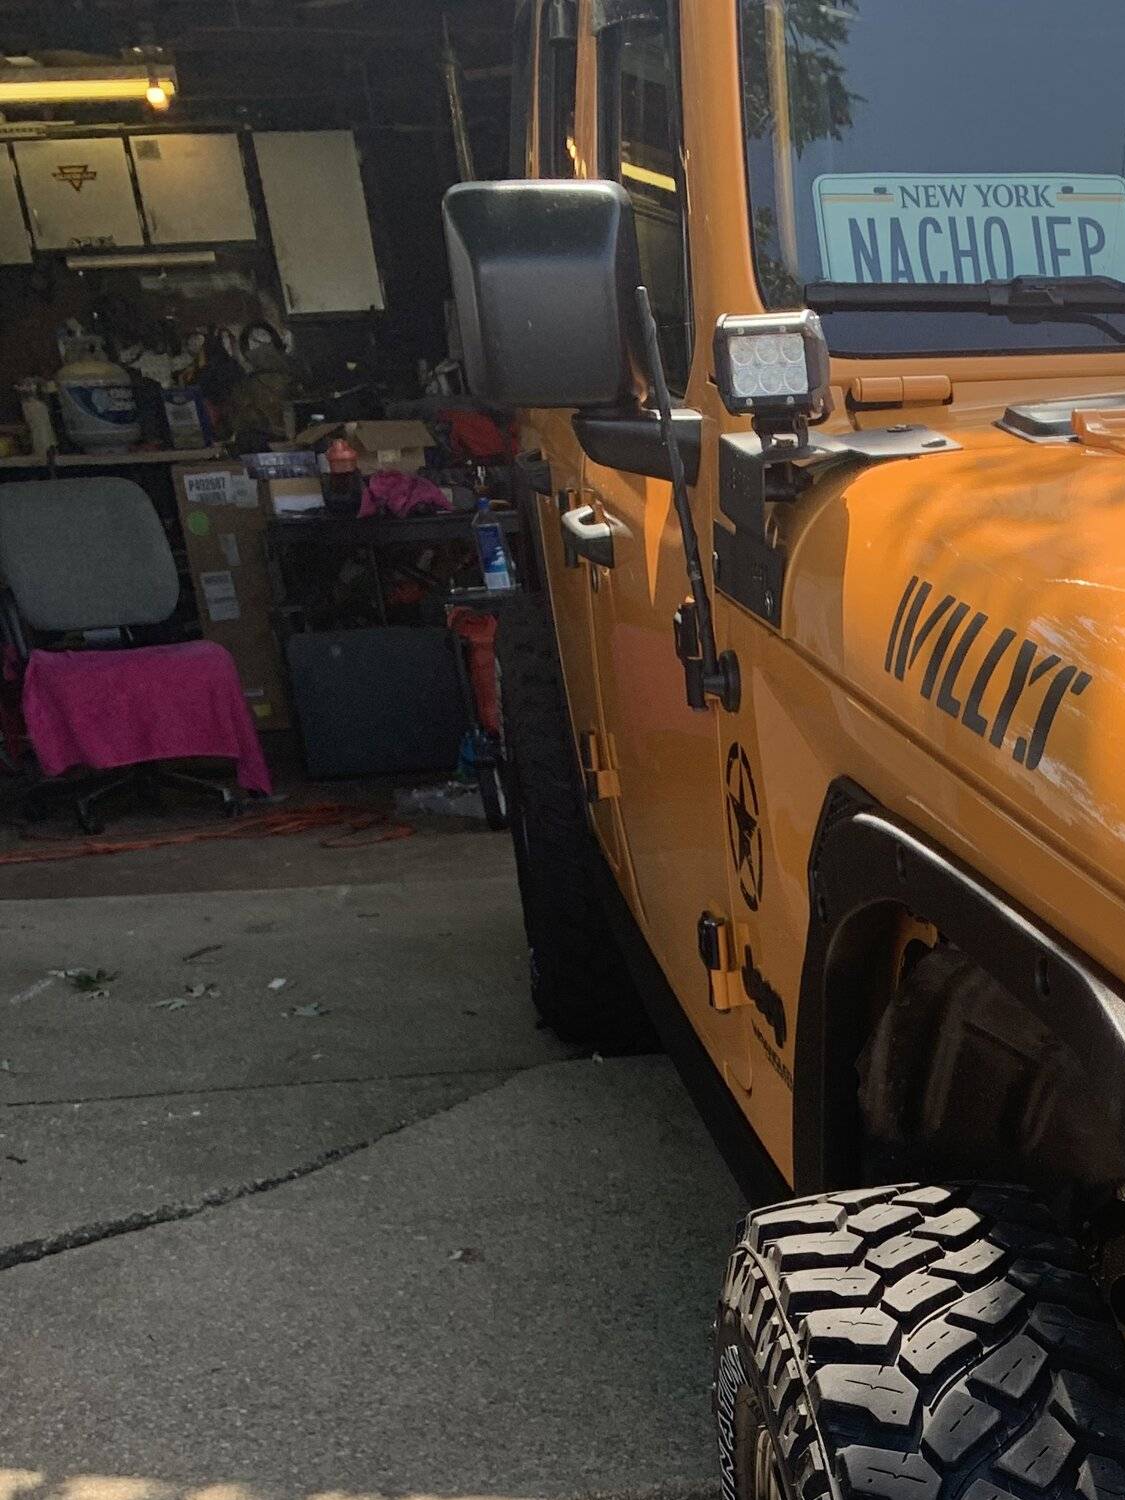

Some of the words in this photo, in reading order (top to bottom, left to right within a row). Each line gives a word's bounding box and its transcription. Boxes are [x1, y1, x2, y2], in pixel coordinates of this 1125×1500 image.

[900, 184, 968, 209] NEW
[973, 183, 1056, 209] YORK
[884, 575, 1093, 771] WILLYS
